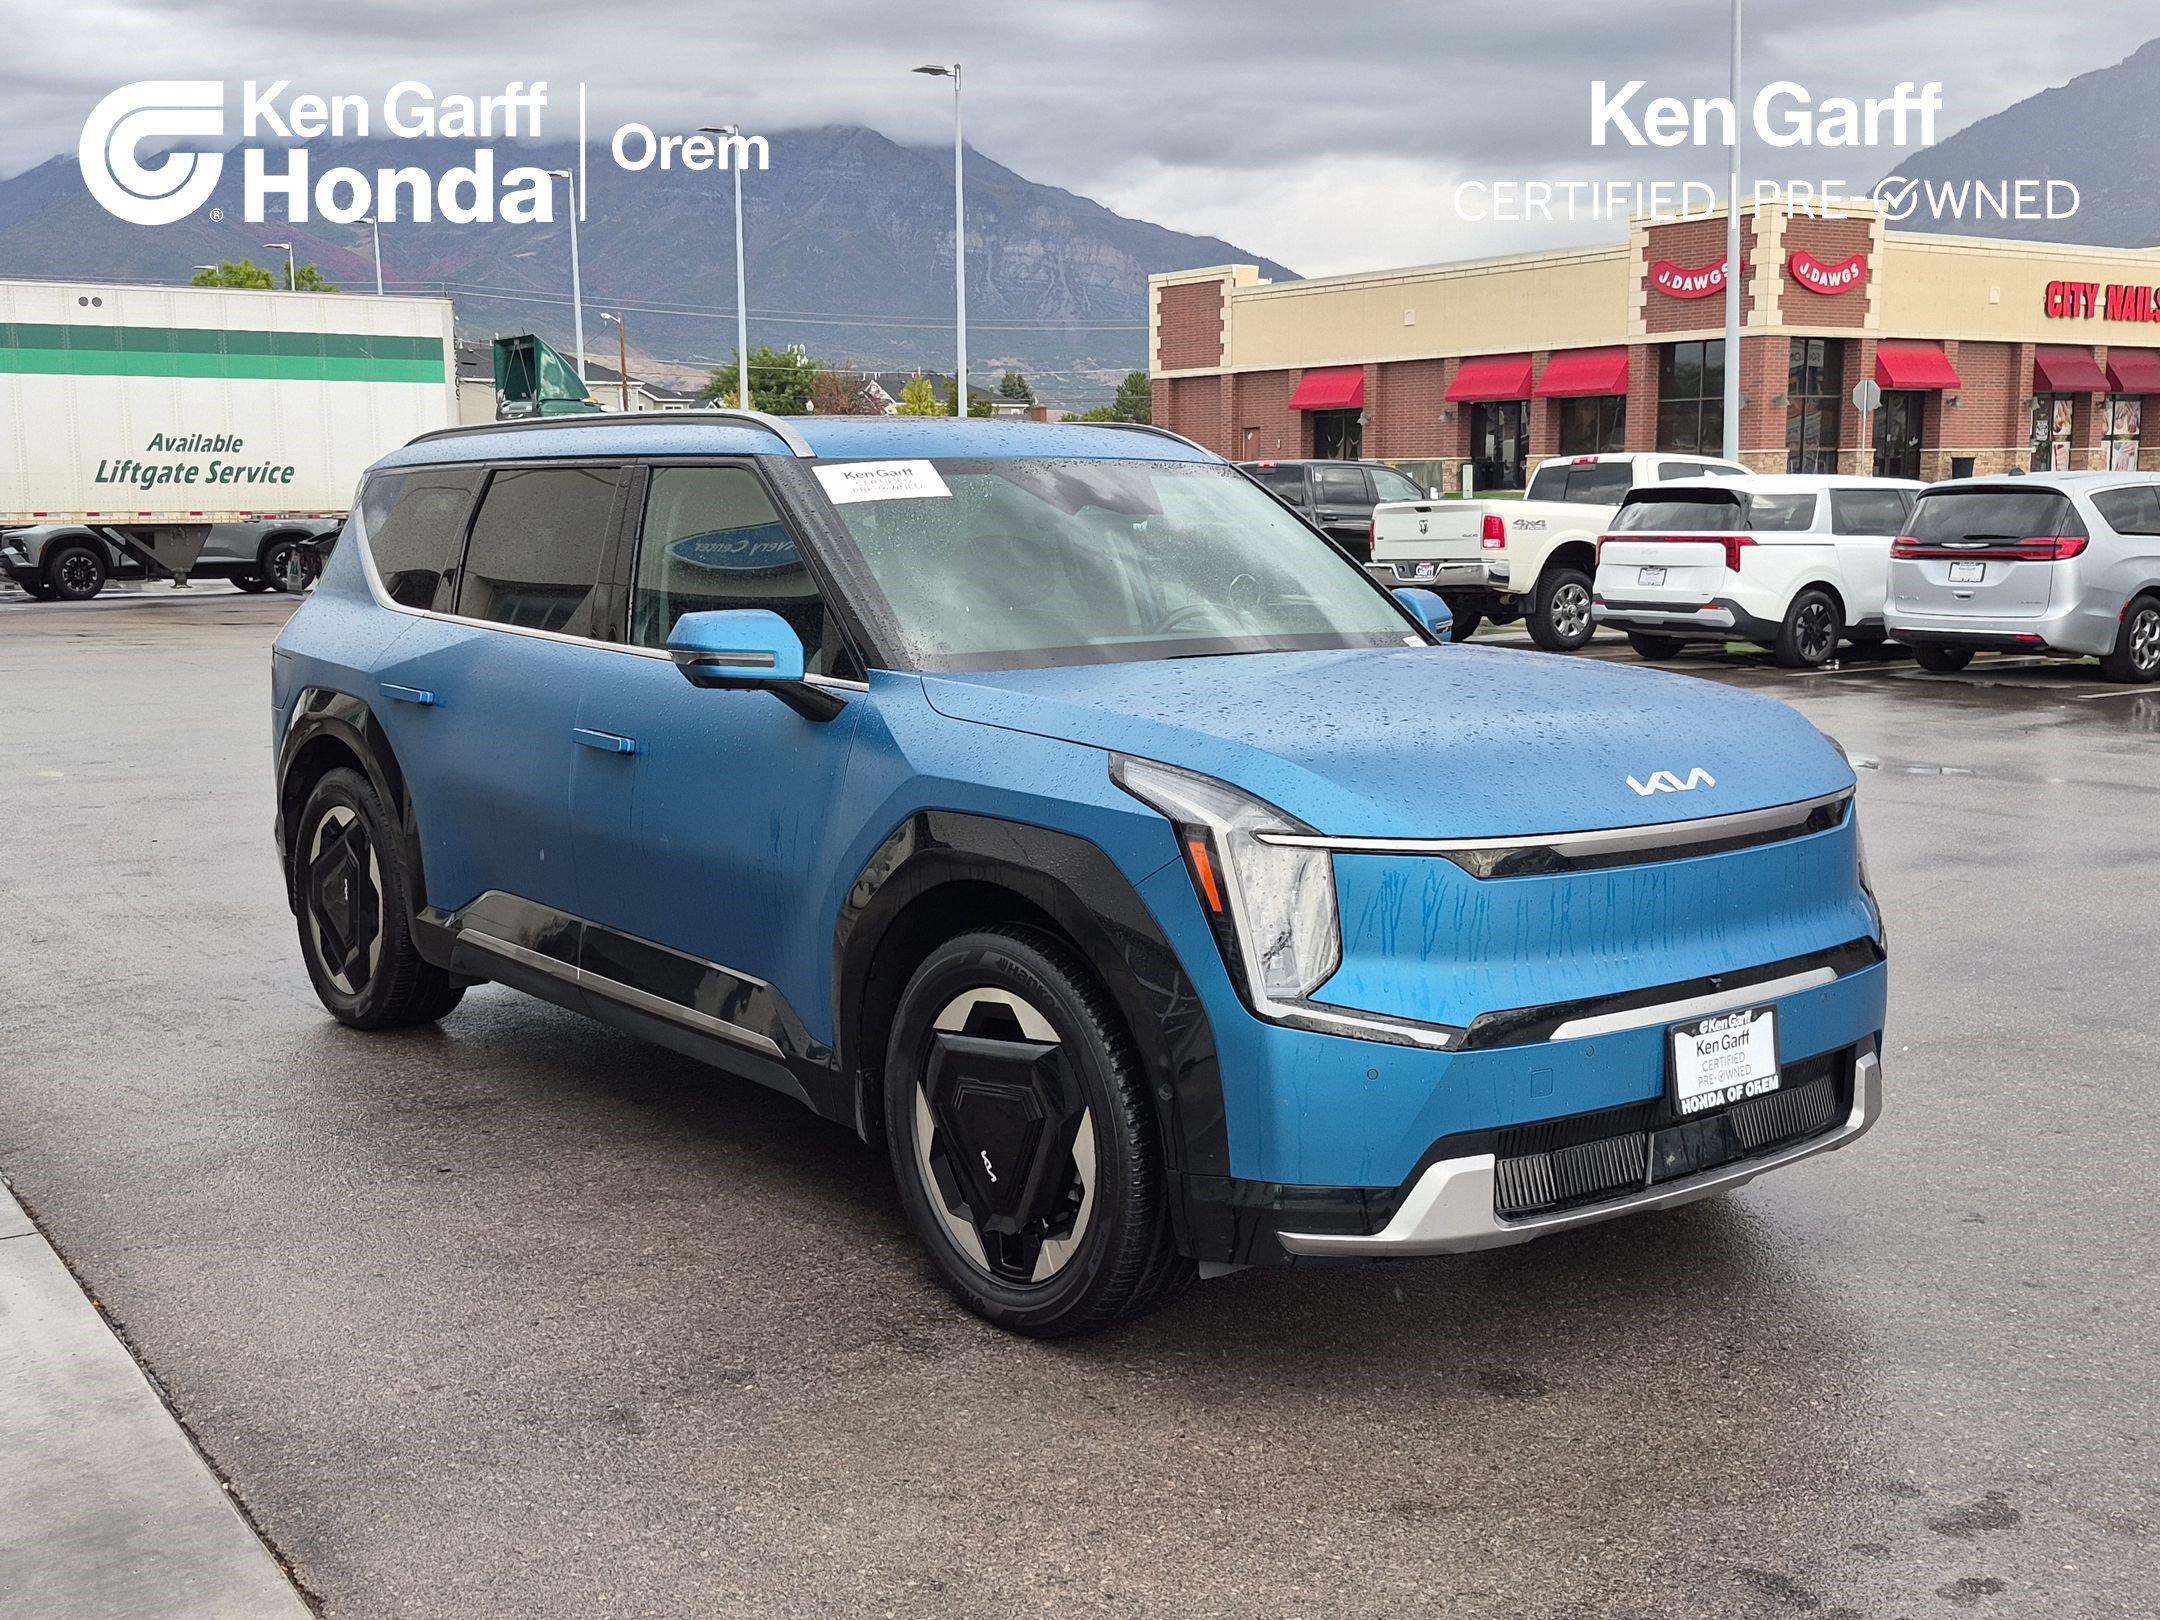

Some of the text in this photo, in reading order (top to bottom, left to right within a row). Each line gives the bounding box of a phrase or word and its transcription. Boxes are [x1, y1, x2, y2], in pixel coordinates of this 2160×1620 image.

[1799, 262, 1860, 287] J.DAWGS
[2046, 280, 2100, 320] CITY
[146, 433, 244, 454] Available
[94, 459, 296, 490] Liftgate Service
[843, 471, 875, 480] Ken
[1625, 768, 1716, 797] KIA
[1708, 1017, 1728, 1033] Ken
[1696, 1029, 1750, 1057] Ken Garff
[1702, 1052, 1746, 1072] CERTIFIED
[1681, 1075, 1779, 1115] HONDA OF OREM
